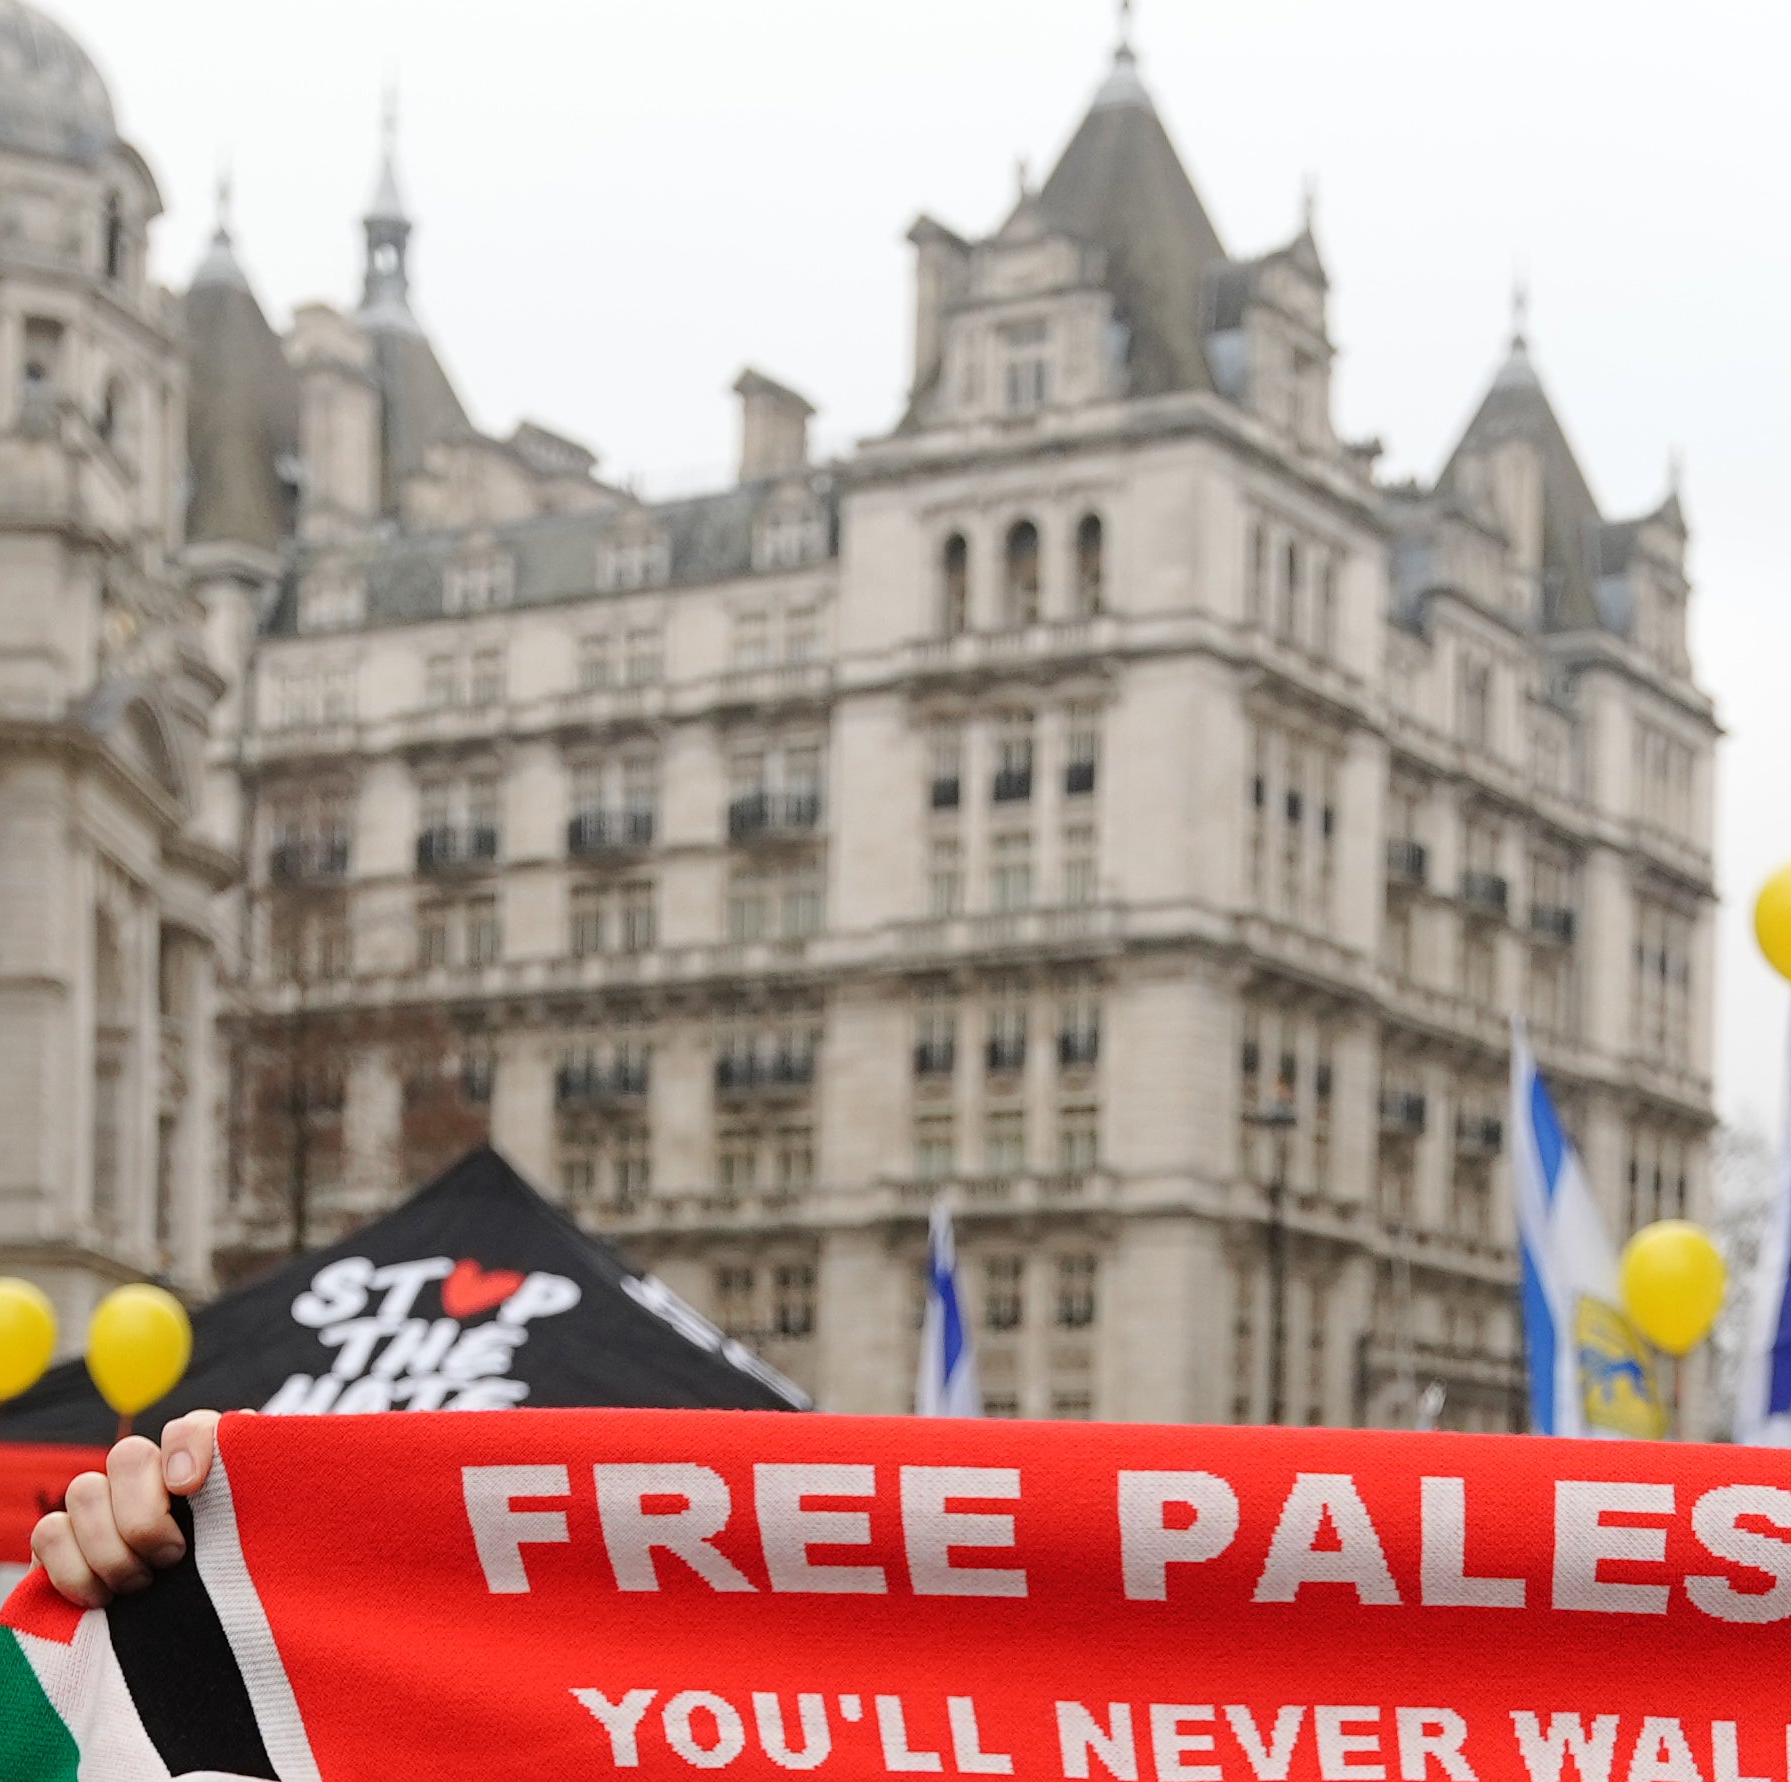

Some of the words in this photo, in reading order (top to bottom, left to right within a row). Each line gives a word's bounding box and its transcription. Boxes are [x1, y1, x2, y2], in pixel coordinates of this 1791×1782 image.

[319, 1316, 528, 1379] THE
[461, 1463, 1028, 1597] FREE
[569, 1688, 1014, 1775] YOU'LL
[1055, 1700, 1479, 1782] NEVER
